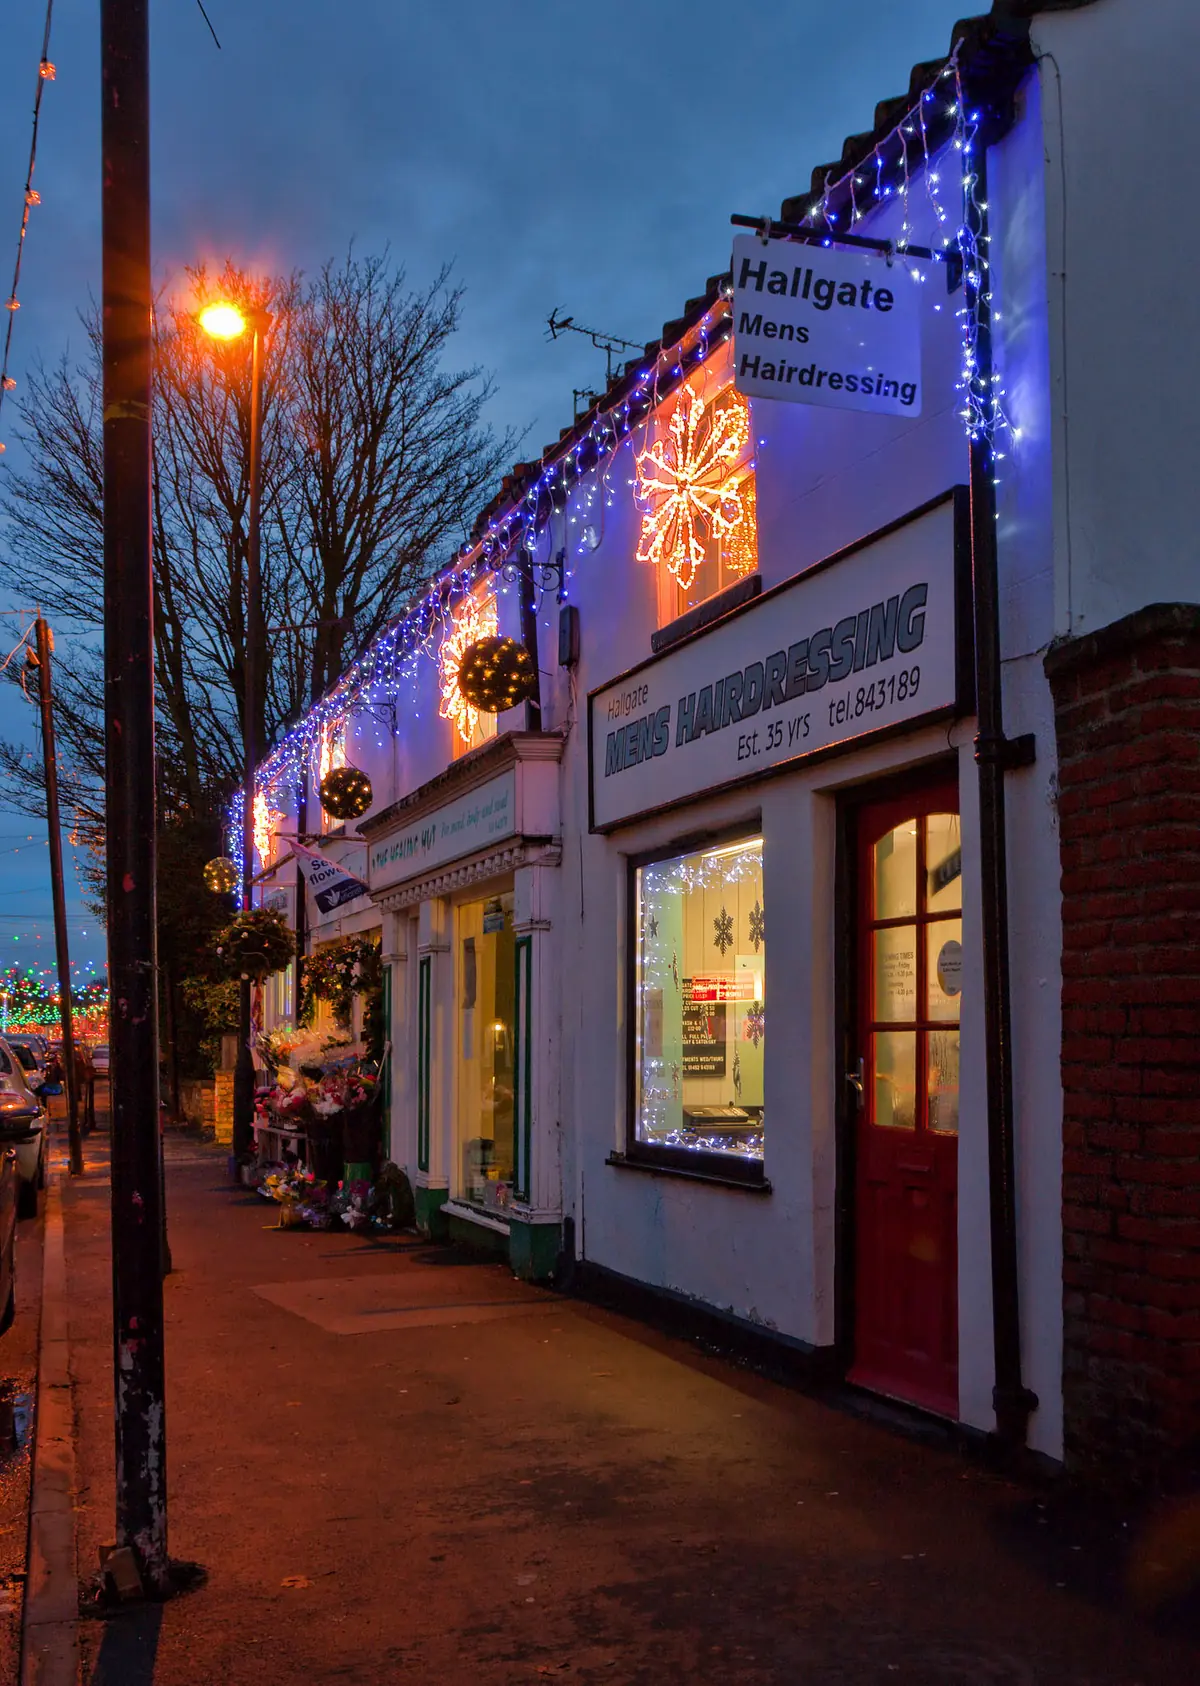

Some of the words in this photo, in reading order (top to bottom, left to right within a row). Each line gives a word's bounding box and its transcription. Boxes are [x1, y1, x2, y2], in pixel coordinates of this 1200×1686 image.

[737, 258, 894, 312] Hallgate
[738, 312, 810, 344] Mens
[739, 354, 917, 406] Hairdressing
[604, 705, 671, 778] MENS
[675, 583, 929, 748] HAIRDRESSING
[607, 684, 649, 722] Hallgate
[737, 729, 761, 761] Est.
[765, 720, 783, 751] 35
[787, 713, 811, 748] yrs
